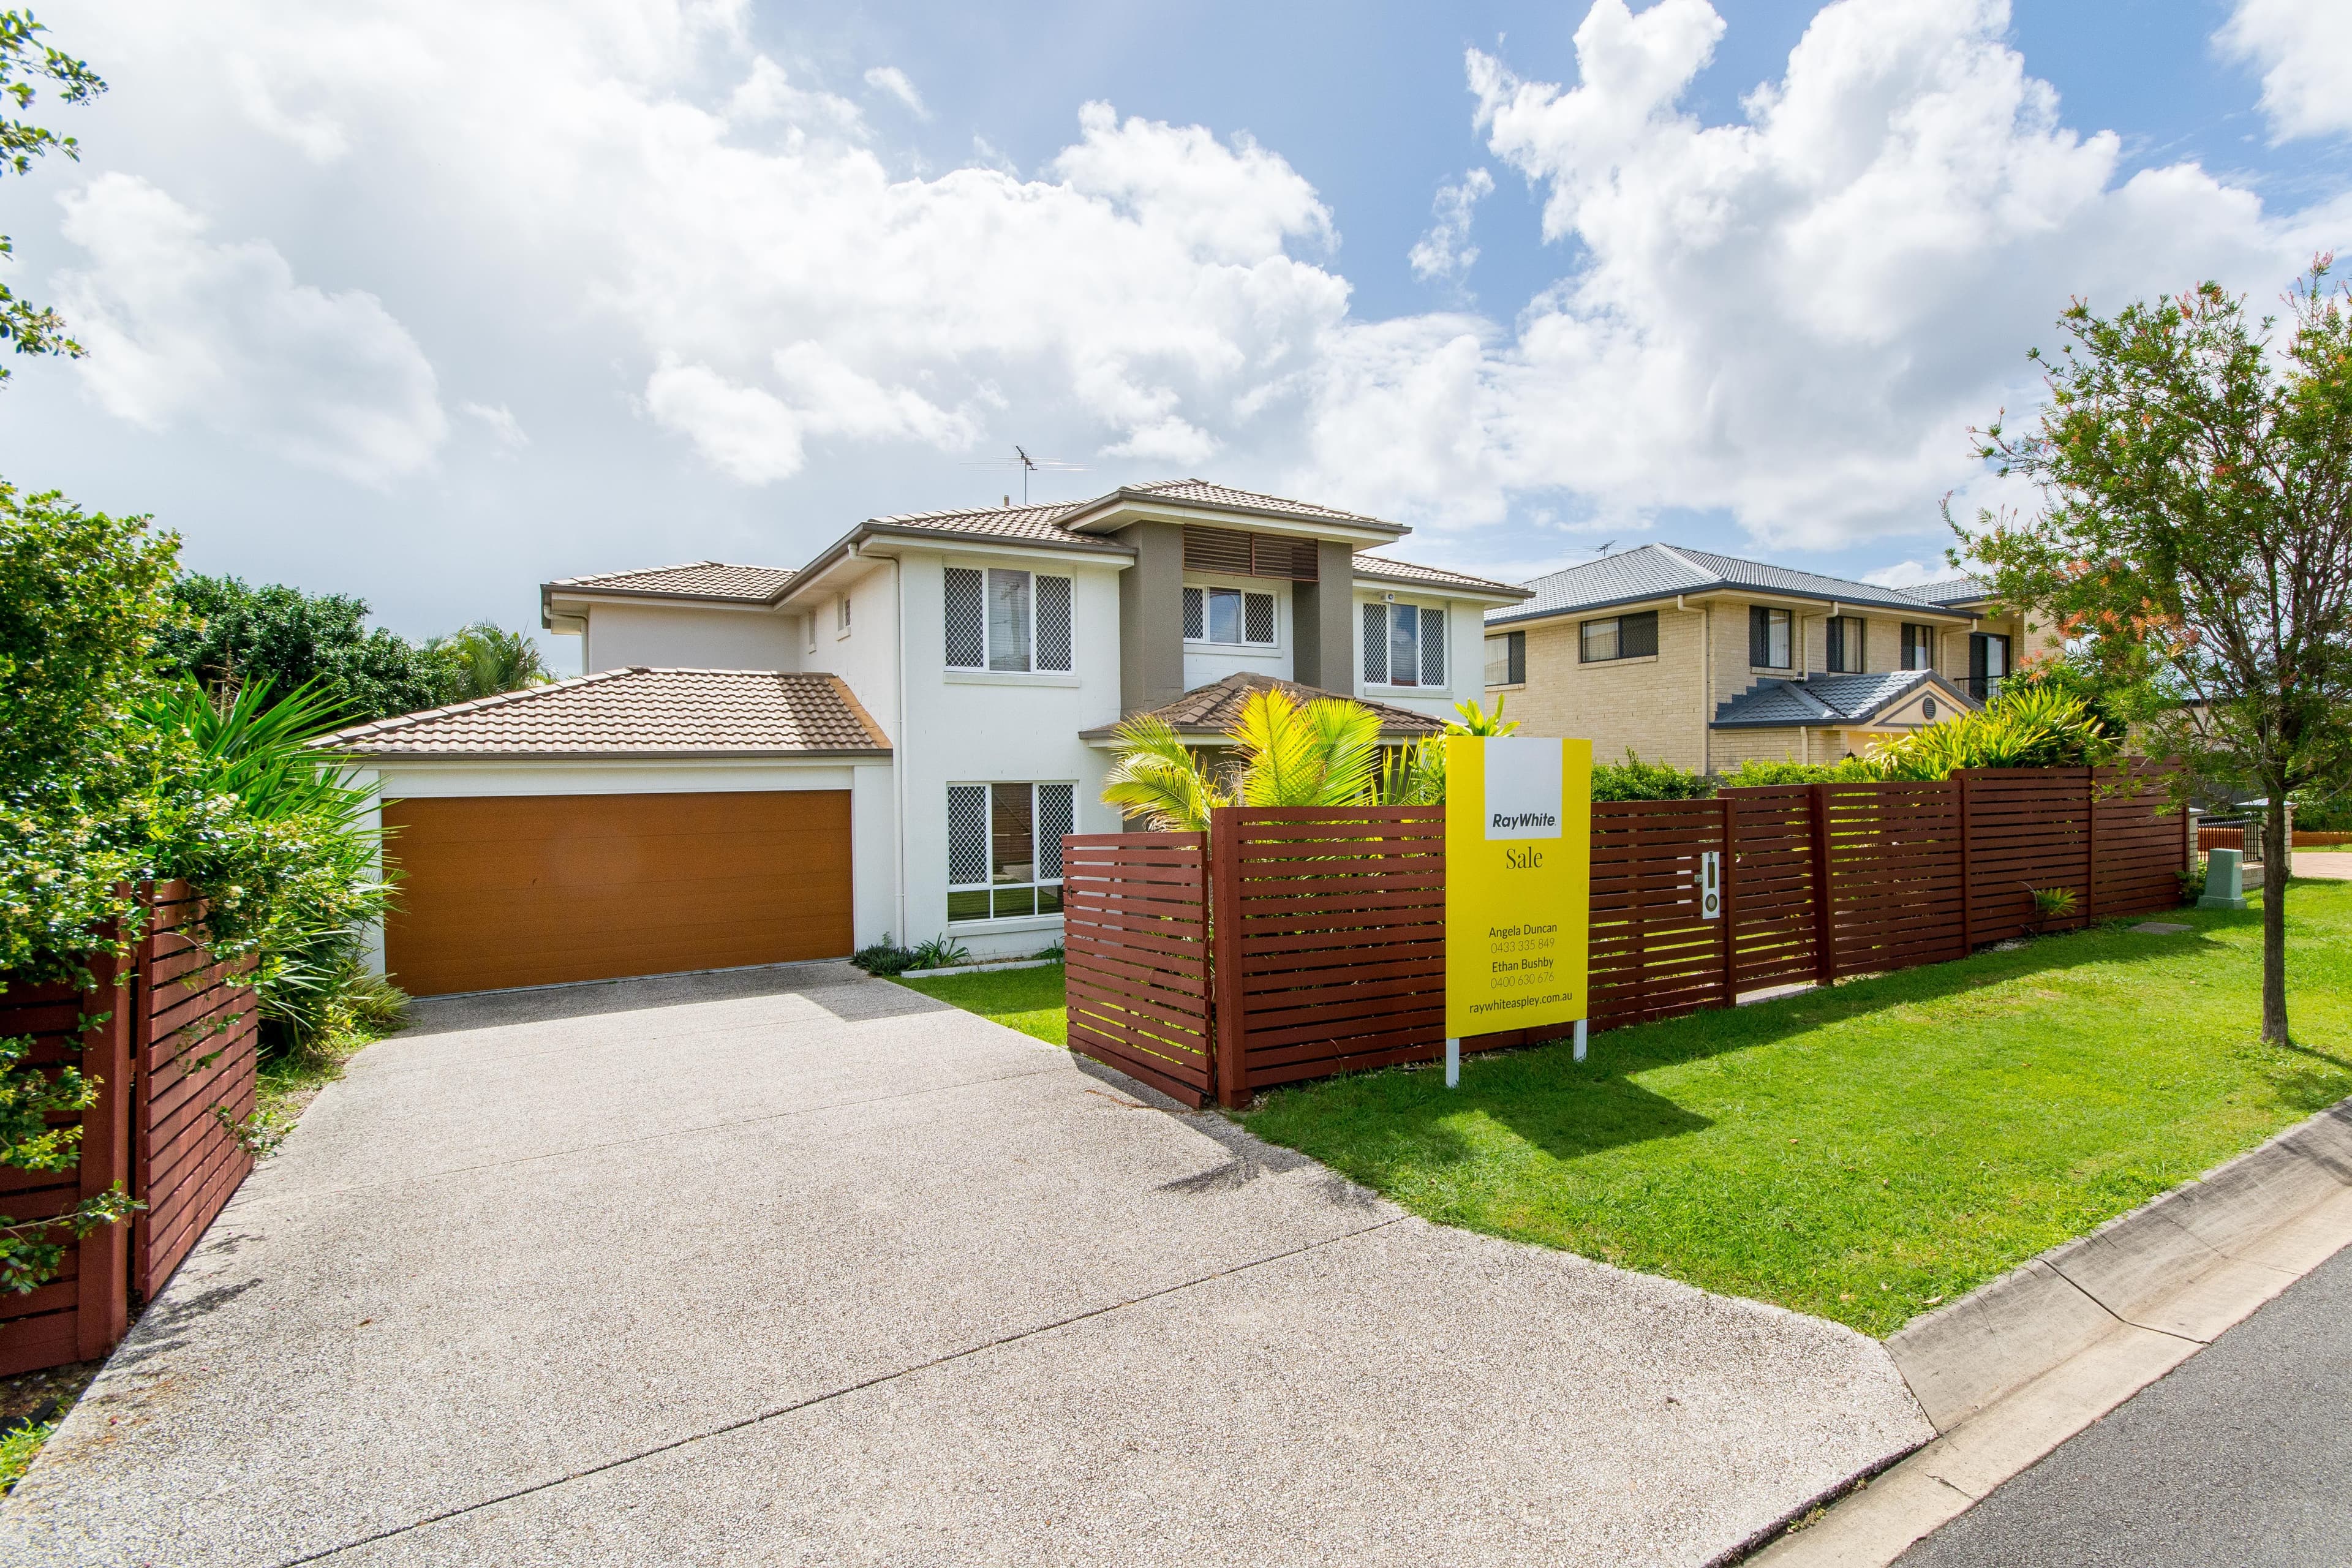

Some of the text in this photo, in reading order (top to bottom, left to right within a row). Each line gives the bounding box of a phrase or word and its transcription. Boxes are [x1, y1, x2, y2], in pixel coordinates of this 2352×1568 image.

[1506, 846, 1543, 869] Sale
[1709, 851, 1713, 862] 9
[1489, 924, 1557, 939] Angela Duncan
[1491, 937, 1555, 954] 0433 335 849
[1492, 956, 1554, 973] Ethan Bushby
[1490, 971, 1555, 989] 0400 630 676
[1469, 992, 1572, 1014] raywhiteaspley.com.au
